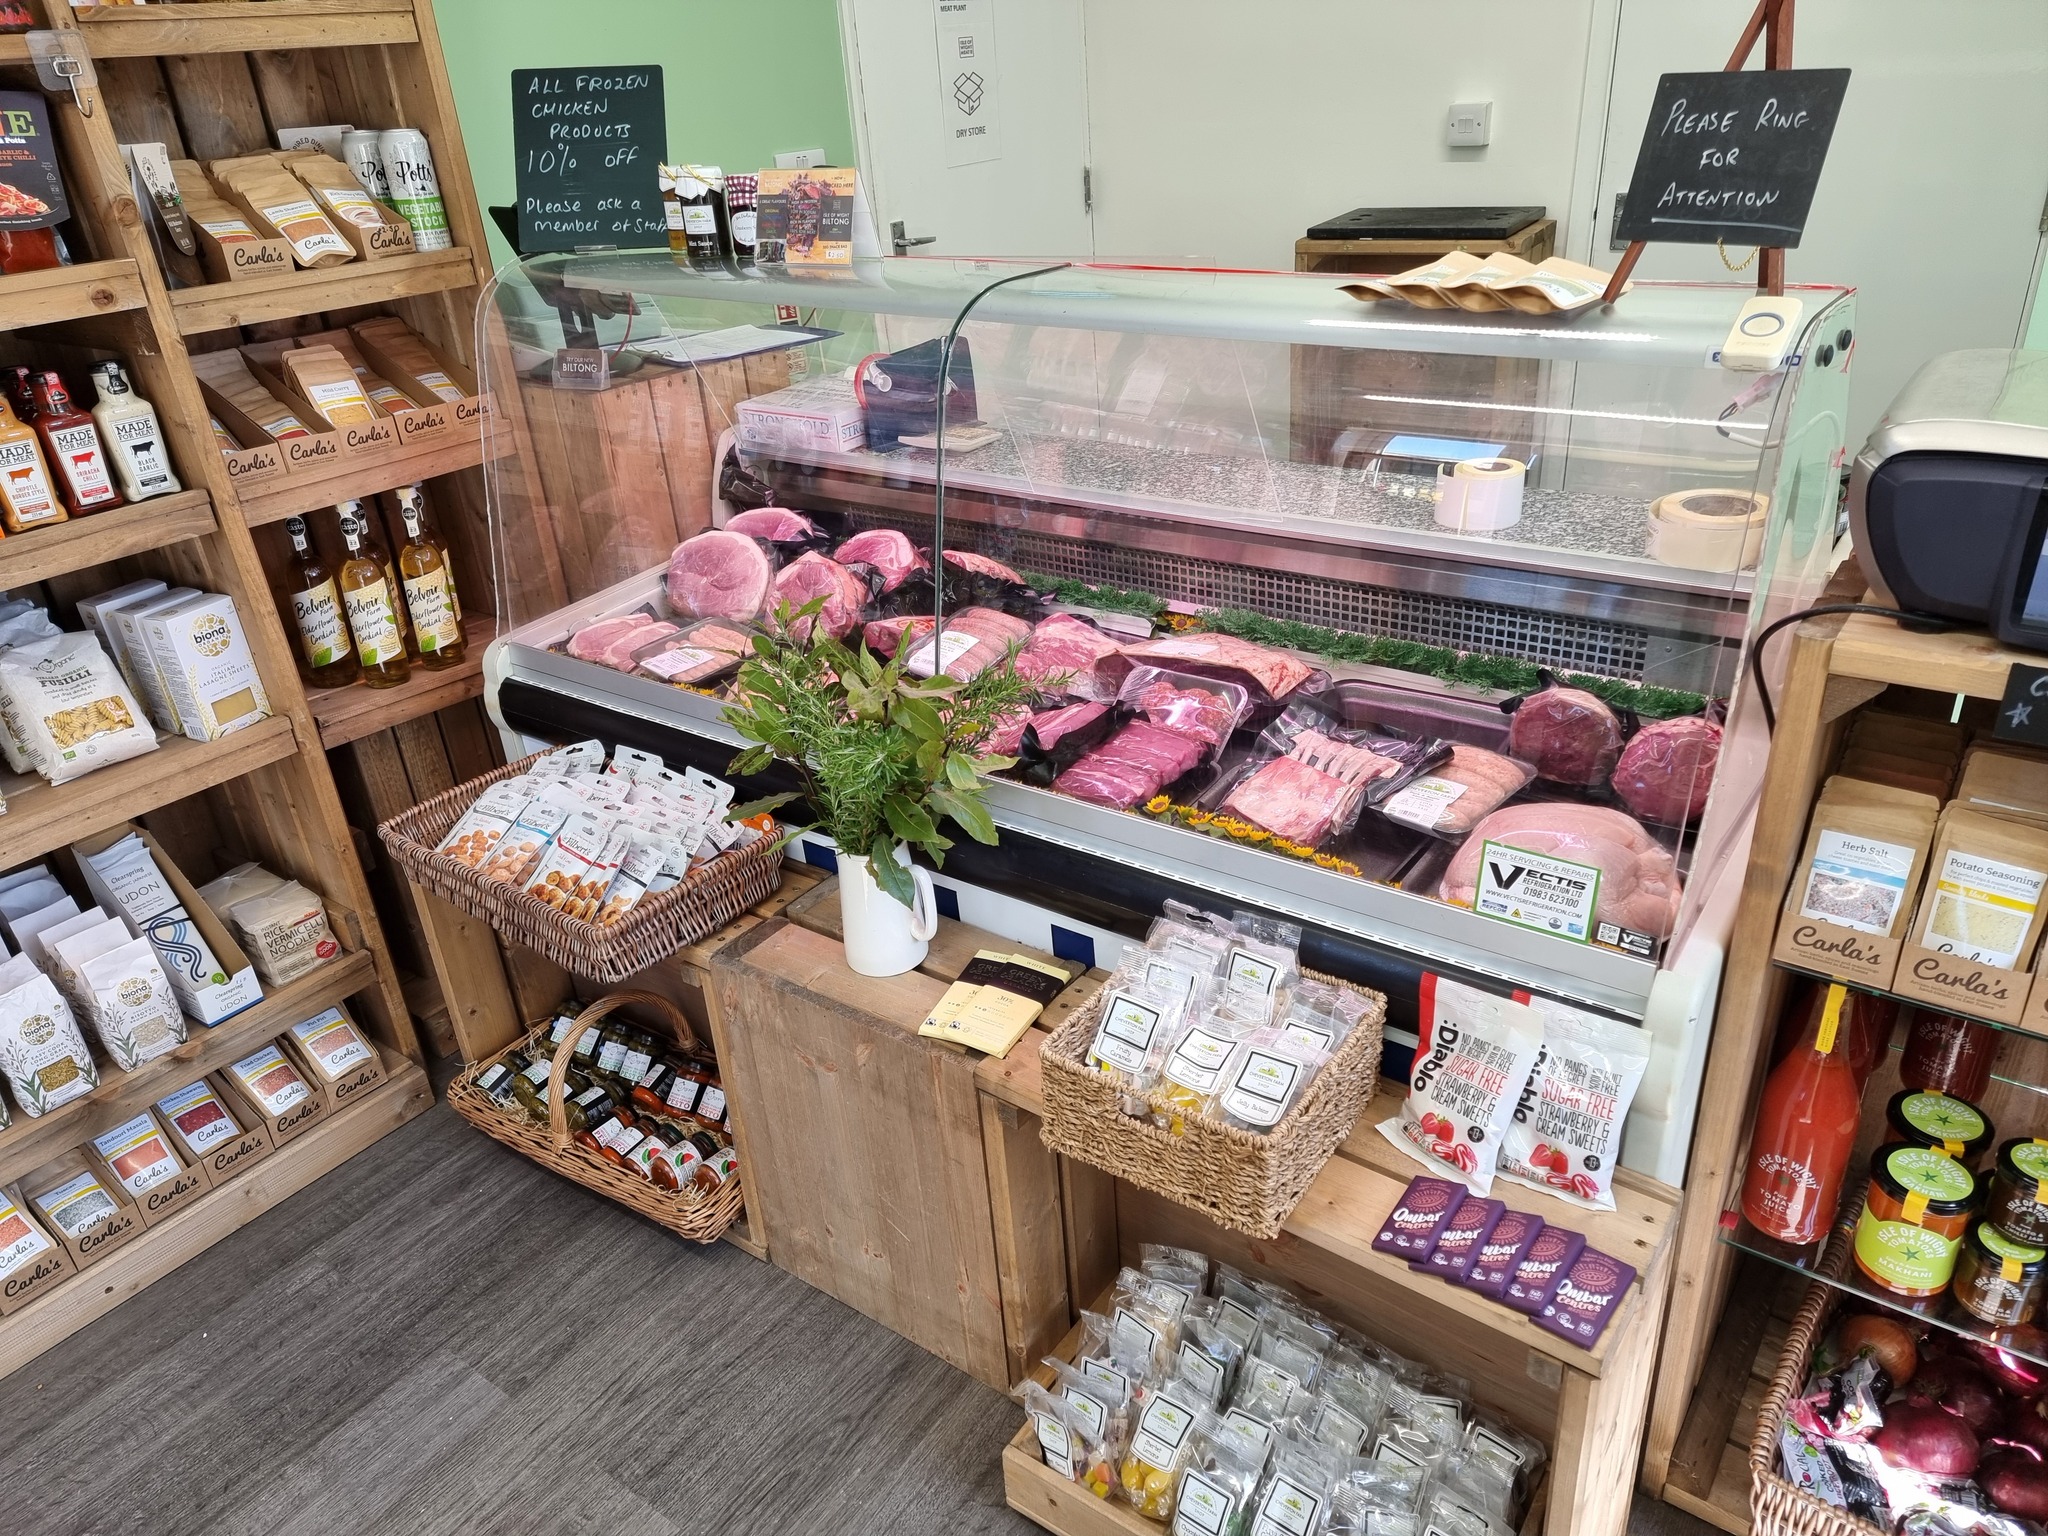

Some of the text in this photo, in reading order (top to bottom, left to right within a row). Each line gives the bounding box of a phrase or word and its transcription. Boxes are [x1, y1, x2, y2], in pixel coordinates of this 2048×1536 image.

[953, 4, 967, 12] PLANT
[528, 74, 649, 95] ALL FROZEN
[531, 98, 608, 118] CHICKEN
[550, 123, 631, 141] PRODUCTS
[956, 126, 986, 138] DRY STORE
[528, 143, 577, 176] 10%
[1699, 147, 1740, 170] FOR
[267, 208, 284, 216] Lamb
[526, 197, 642, 214] Please ask a
[411, 217, 444, 228] STOCK
[534, 219, 600, 233] member
[611, 218, 629, 232] of
[233, 246, 284, 267] Carla's
[562, 364, 598, 373] BILTONG
[321, 384, 350, 394] Mild Curry
[116, 419, 153, 436] MADE
[134, 428, 155, 438] MEAT
[347, 425, 391, 448] Carla's
[57, 429, 94, 446] MADE
[59, 440, 96, 451] FOR MEAT
[290, 440, 337, 461] Carla's
[138, 458, 156, 467] BLACK
[227, 453, 276, 477] Carla's
[76, 468, 100, 477] SRIRACHA
[406, 584, 439, 606] Belvoir
[426, 594, 441, 605] Farm
[295, 594, 332, 620] Belvoir
[320, 605, 334, 616] Farm
[346, 596, 380, 619] Belvoir
[366, 607, 381, 617] Farm
[417, 617, 442, 632] Cordial
[193, 626, 226, 644] biona
[310, 626, 337, 645] Cordial
[357, 627, 383, 644] Cordial
[39, 670, 92, 688] FUSILLI
[199, 664, 250, 689] LASAGNE SHEETS
[211, 665, 235, 678] ITALIAN
[566, 838, 594, 858] Filbert's
[1841, 840, 1889, 859] Herb Salt
[1487, 848, 1508, 858] 24HR
[1509, 854, 1551, 870] SERVICING
[1560, 867, 1595, 880] REPAIRS
[1949, 857, 1984, 875] Potato
[1984, 866, 2042, 890] Seasoning
[110, 866, 145, 884] Clearspring
[1489, 861, 1588, 891] VECTIS
[119, 881, 161, 905] UDON
[1522, 877, 1583, 898] REFRIGERATION LTD
[1523, 886, 1580, 908] 01983 623100
[1485, 889, 1582, 919] WWW.VECTISREFRIGERATION.COM
[263, 924, 286, 941] RICE
[265, 917, 326, 949] VERMICELLI
[269, 929, 321, 958] NOODLES
[1792, 925, 1882, 965] Carla's
[1026, 961, 1047, 970] WHITE
[1912, 957, 2009, 1001] Carla's
[121, 985, 148, 1000] biona
[220, 994, 248, 1012] UDON
[24, 1021, 51, 1038] biona
[316, 1016, 327, 1024] Piri
[1115, 1016, 1148, 1033] CHEVERTON FARM
[240, 1051, 273, 1070] Fried Chicken
[1494, 1057, 1514, 1074] FREE
[1564, 1058, 1589, 1075] PANGS
[336, 1069, 380, 1098] Carla's
[620, 1068, 644, 1081] PESTO
[1249, 1071, 1285, 1087] CHEVERTON FARM
[1446, 1055, 1480, 1082] SUGAR
[1477, 1067, 1509, 1096] FREE
[1436, 1072, 1497, 1112] STRAWBERRY &
[669, 1097, 691, 1109] PESTO
[698, 1106, 720, 1118] PESTO
[1430, 1085, 1493, 1128] CREAM SWEETS
[1586, 1092, 1617, 1121] FREE
[1908, 1097, 1976, 1122] ISLE OF WIGHT
[277, 1101, 321, 1133] Carla's
[1538, 1101, 1610, 1138] STRAWBERRY &
[99, 1119, 148, 1147] Tandoori Masala
[1535, 1117, 1608, 1155] CREAM SWEETS
[1926, 1127, 1971, 1139] MAKHANI
[214, 1137, 263, 1171] Carla's
[1758, 1154, 1818, 1190] ISLE OF WIGHT
[1895, 1152, 1968, 1190] ISLE OF WIGHT
[1909, 1160, 1953, 1184] TOMATOES
[55, 1183, 77, 1196] Tuscan
[148, 1176, 199, 1211] Carla's
[1900, 1177, 1948, 1198] MAKHANI
[1760, 1188, 1800, 1210] TOMATO
[2006, 1199, 2035, 1211] ISLE OF
[1392, 1207, 1446, 1223] Ombar
[80, 1217, 133, 1253] Carla's
[1394, 1221, 1435, 1230] Centres
[2004, 1225, 2028, 1240] CHILLI
[2006, 1221, 2037, 1237] TOMATO
[1877, 1226, 1948, 1259] ISLE OF WIGHT
[1887, 1236, 1935, 1260] TOMATOES
[1878, 1257, 1933, 1278] MAKHANI
[5, 1259, 62, 1297] Carla's
[1556, 1279, 1614, 1306] Ombar
[1556, 1295, 1602, 1313] Centres
